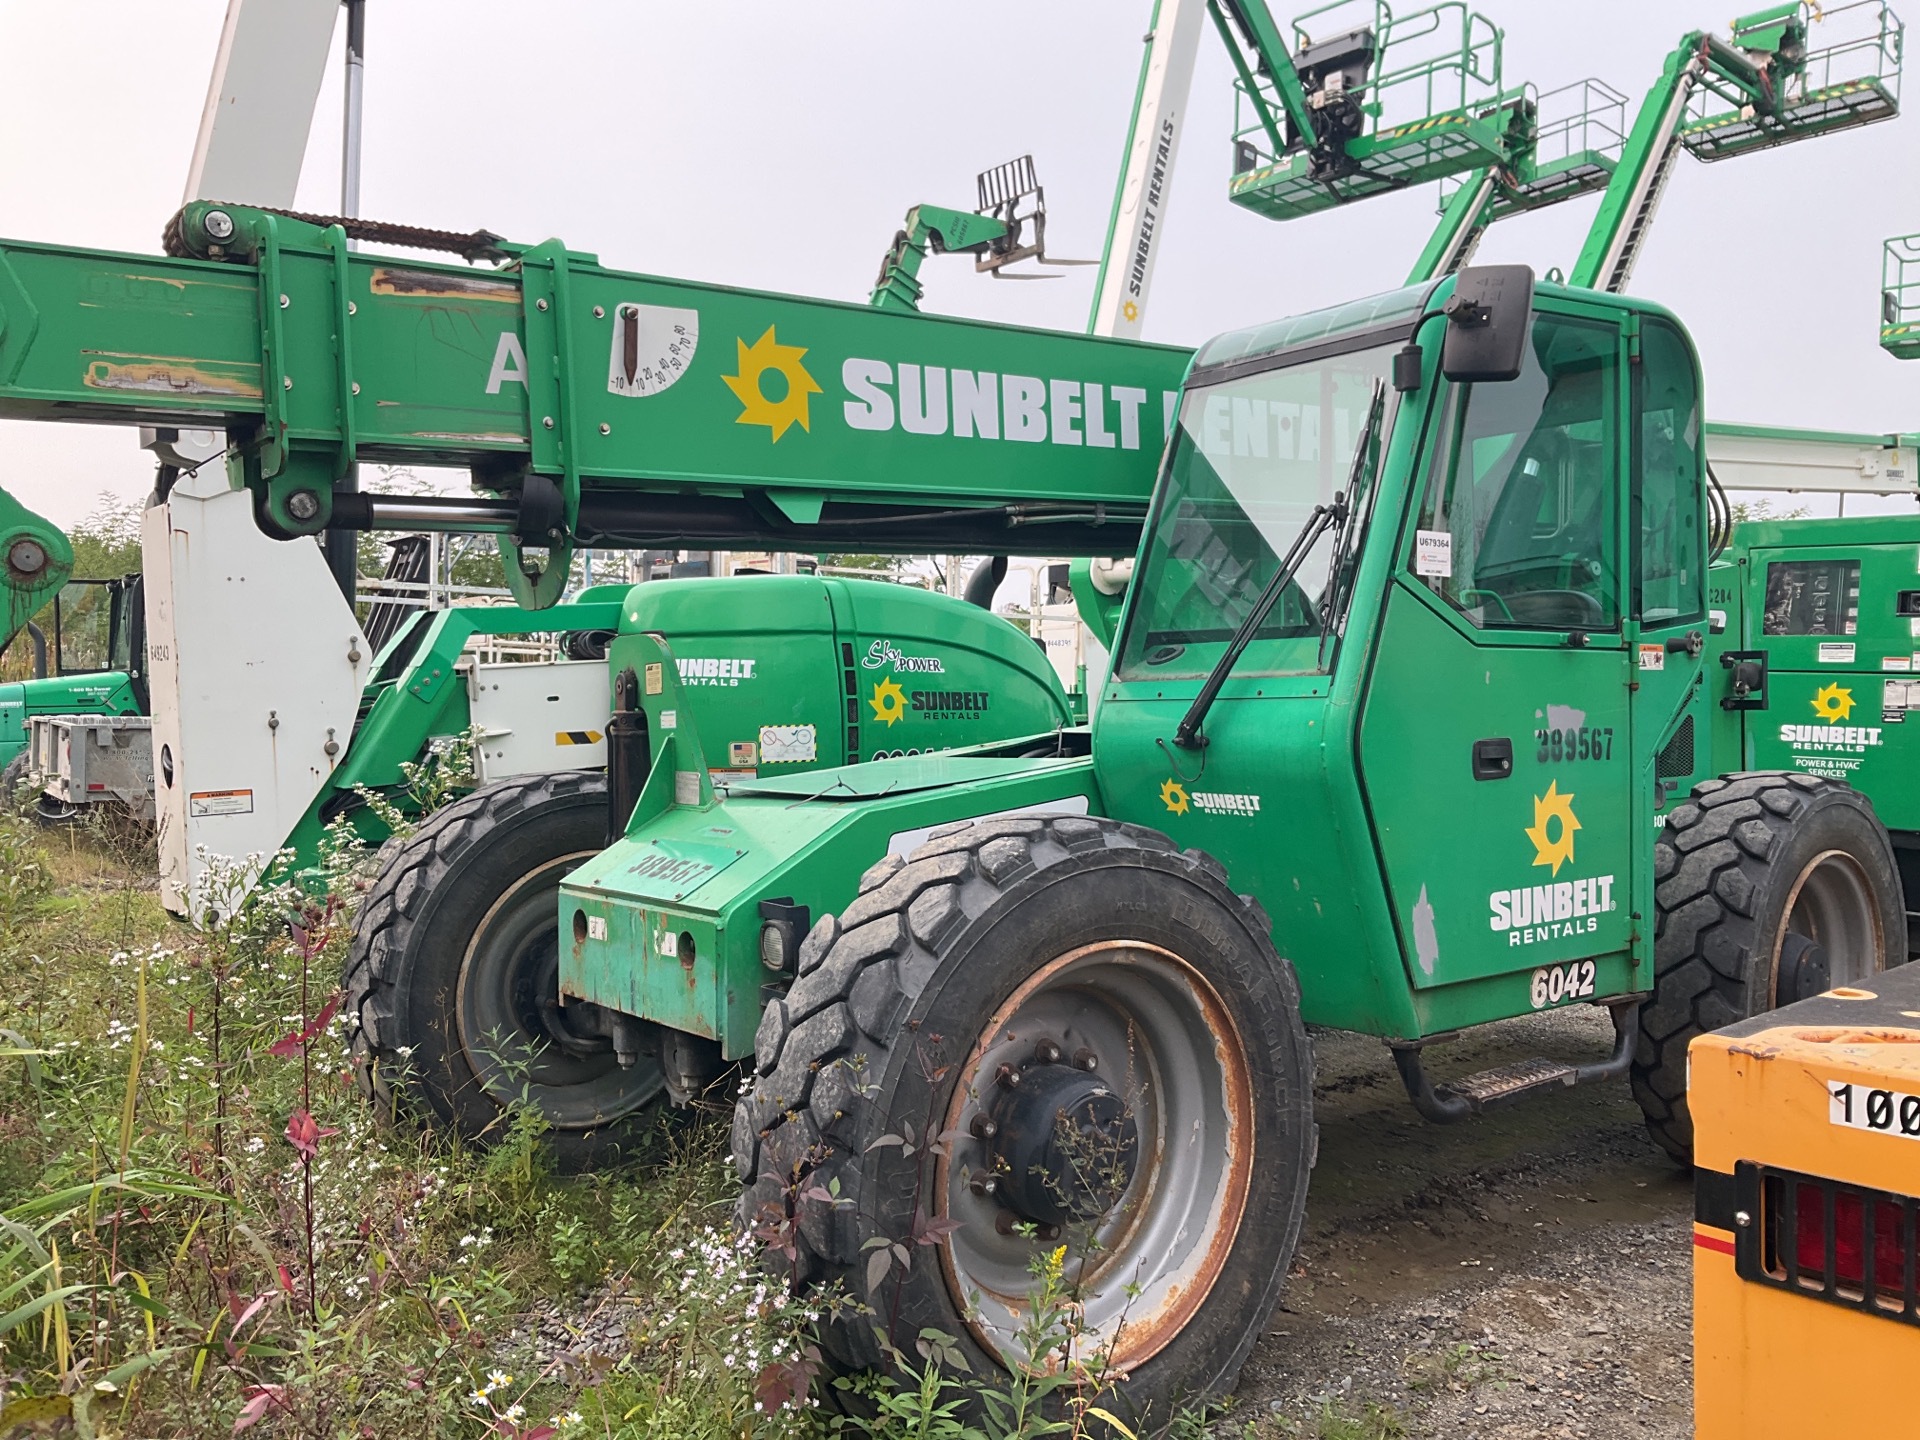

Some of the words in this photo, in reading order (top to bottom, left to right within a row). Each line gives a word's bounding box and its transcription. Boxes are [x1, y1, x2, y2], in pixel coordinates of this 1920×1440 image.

[1128, 207, 1157, 298] SUNBELT
[1147, 118, 1174, 208] RENTALS
[679, 337, 691, 349] 70
[658, 357, 670, 370] 40
[642, 367, 653, 381] 20
[654, 370, 667, 385] 30
[635, 377, 646, 391] 10
[841, 357, 1147, 451] SUNBELT
[675, 659, 756, 679] UNBELT
[681, 678, 739, 687] ENTALS
[911, 690, 989, 711] SUNBELT
[923, 712, 981, 720] RENTALS
[1779, 724, 1882, 746] SUNBELT
[1536, 727, 1614, 764] 389567
[1792, 742, 1865, 753] RENTALS
[1795, 758, 1826, 768] POWER
[1827, 760, 1834, 769] &
[1835, 761, 1860, 770] HVAC
[1808, 768, 1847, 778] SERVICES
[1191, 791, 1261, 811] SUNBELT
[1204, 807, 1255, 817] RENTALS
[627, 854, 714, 886] 389567
[1489, 874, 1615, 932] SUNBELT
[1508, 916, 1598, 947] RENTALS
[1529, 960, 1597, 1009] 6042
